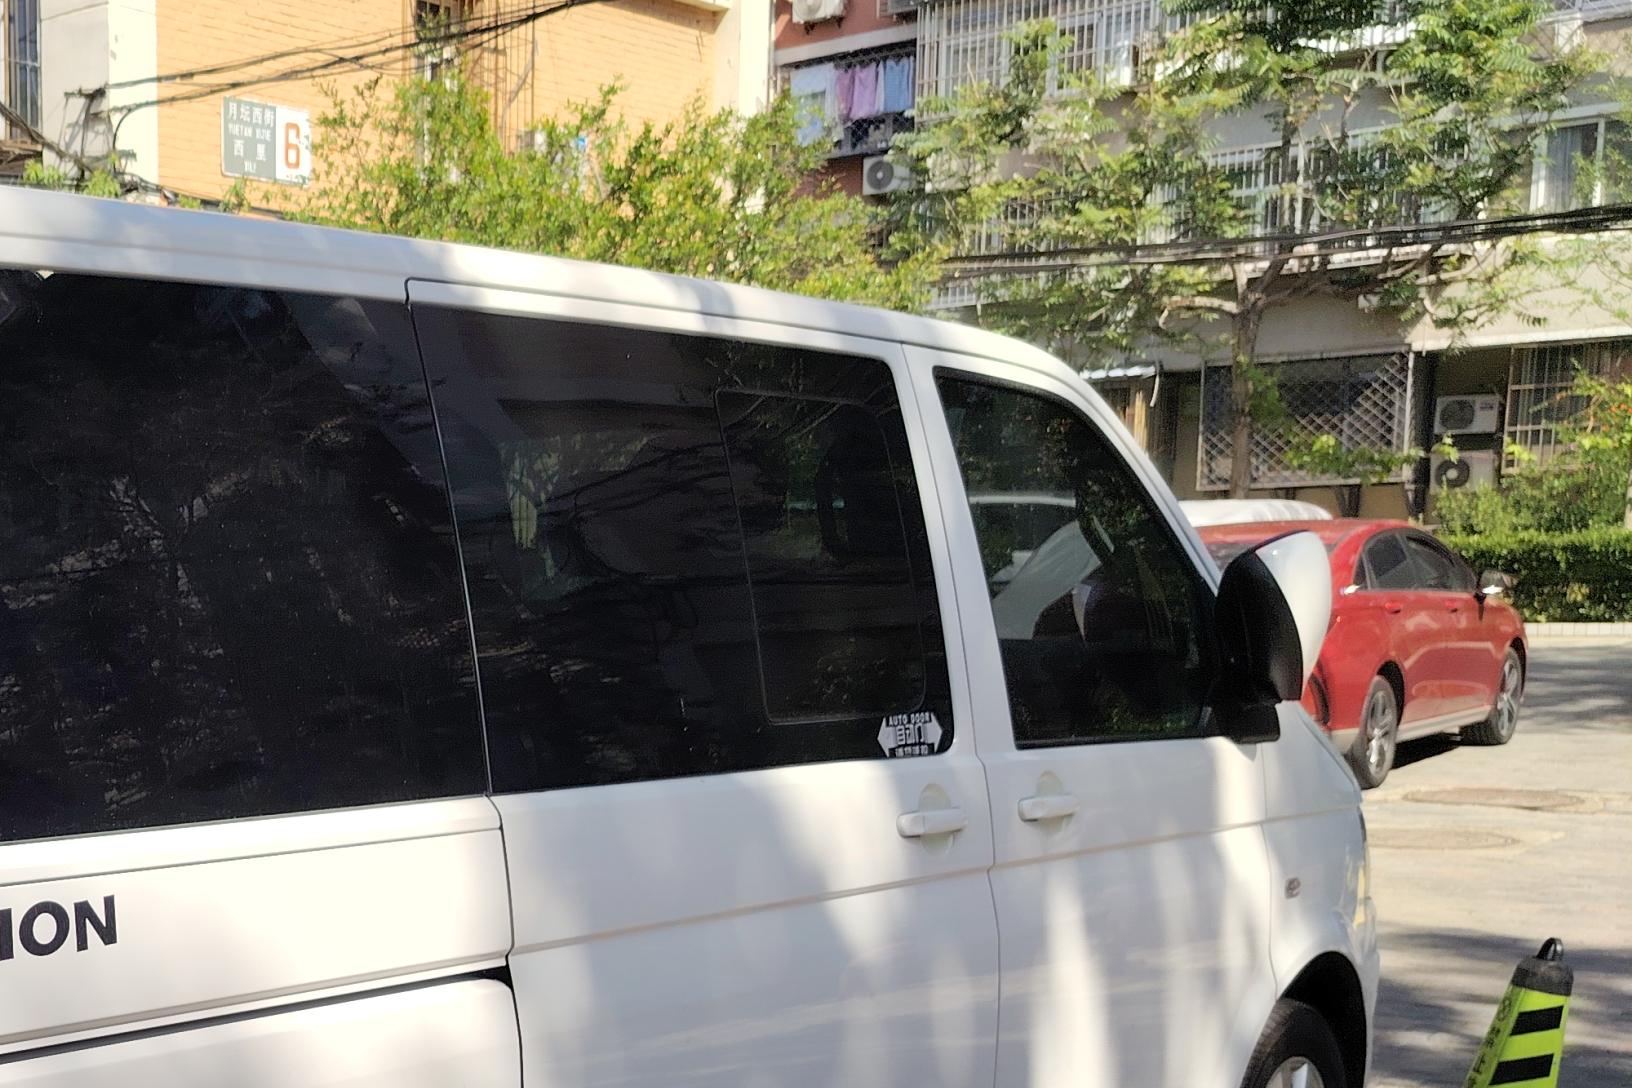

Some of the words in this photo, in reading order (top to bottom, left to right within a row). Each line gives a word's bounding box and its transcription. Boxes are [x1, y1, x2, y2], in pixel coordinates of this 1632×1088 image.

[227, 101, 274, 127] 月坛西街
[285, 122, 300, 169] 6
[889, 713, 908, 726] AUTO
